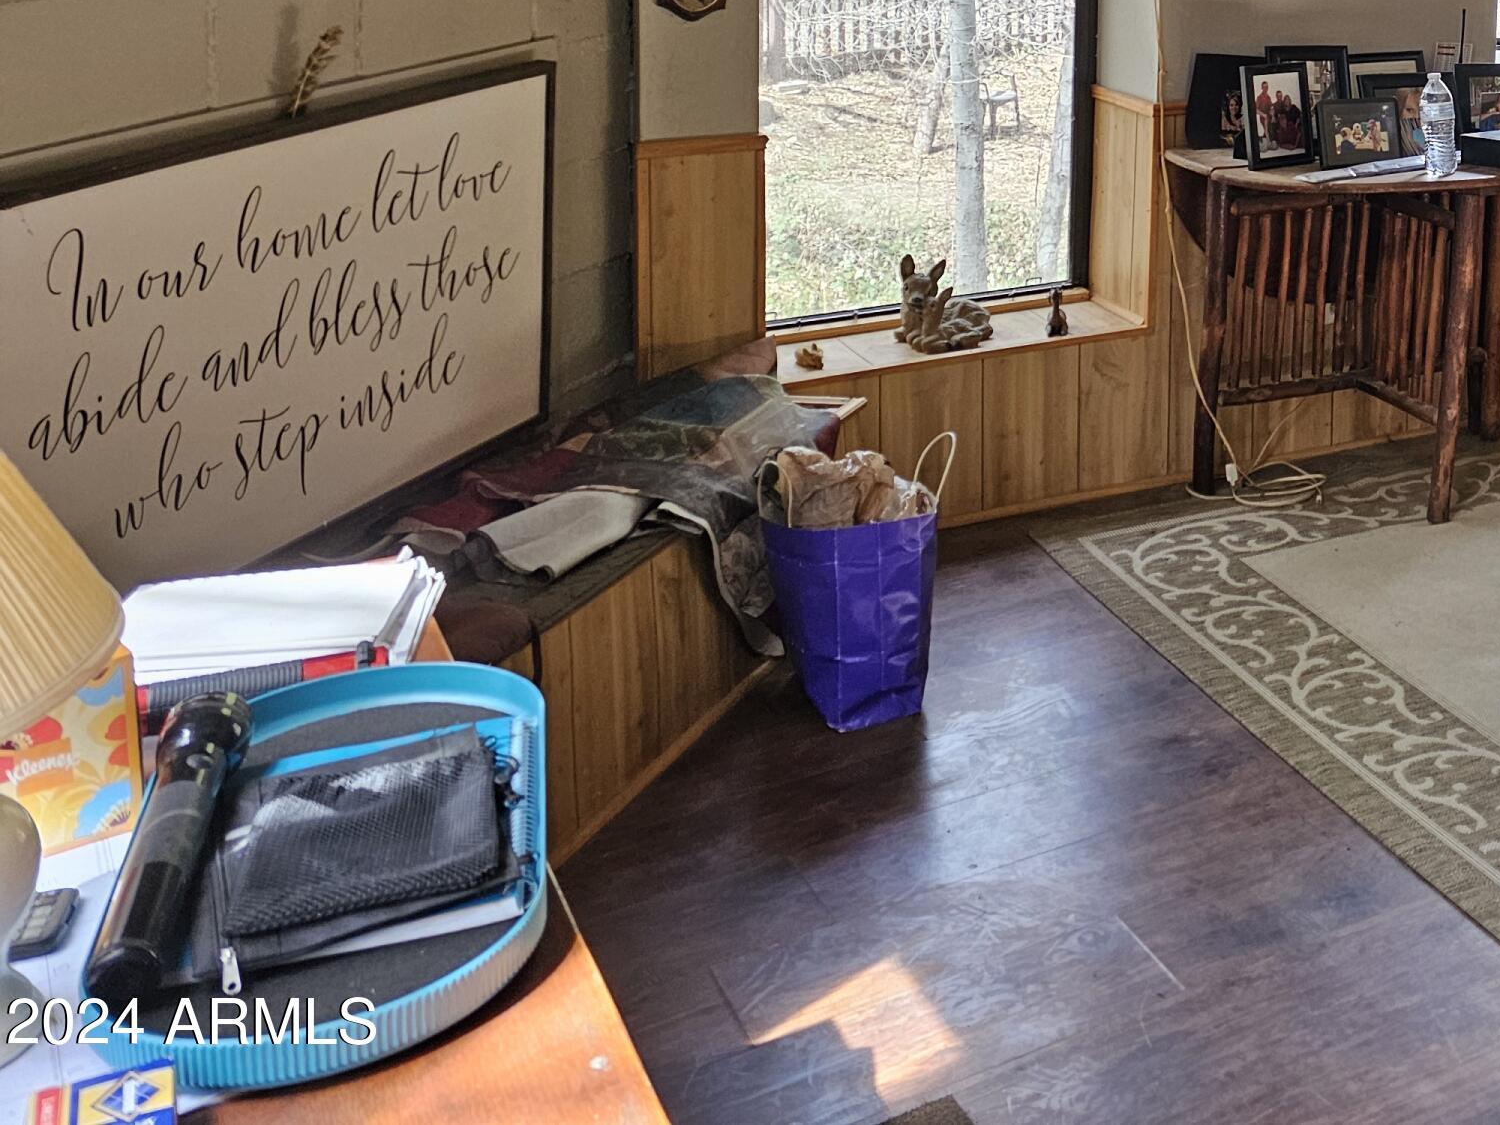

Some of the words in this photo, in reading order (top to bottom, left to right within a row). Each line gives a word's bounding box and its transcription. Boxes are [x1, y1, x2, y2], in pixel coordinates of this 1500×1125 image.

[47, 228, 124, 331] In
[138, 241, 223, 302] our
[237, 185, 361, 273] home
[372, 149, 439, 233] let
[438, 132, 511, 201] love
[28, 325, 188, 461] abide
[202, 278, 299, 392] and
[308, 260, 412, 355] bless
[407, 225, 520, 313] those
[115, 421, 222, 539] who
[234, 405, 328, 500] step
[340, 312, 465, 432] inside
[5, 753, 80, 786] Kleenex
